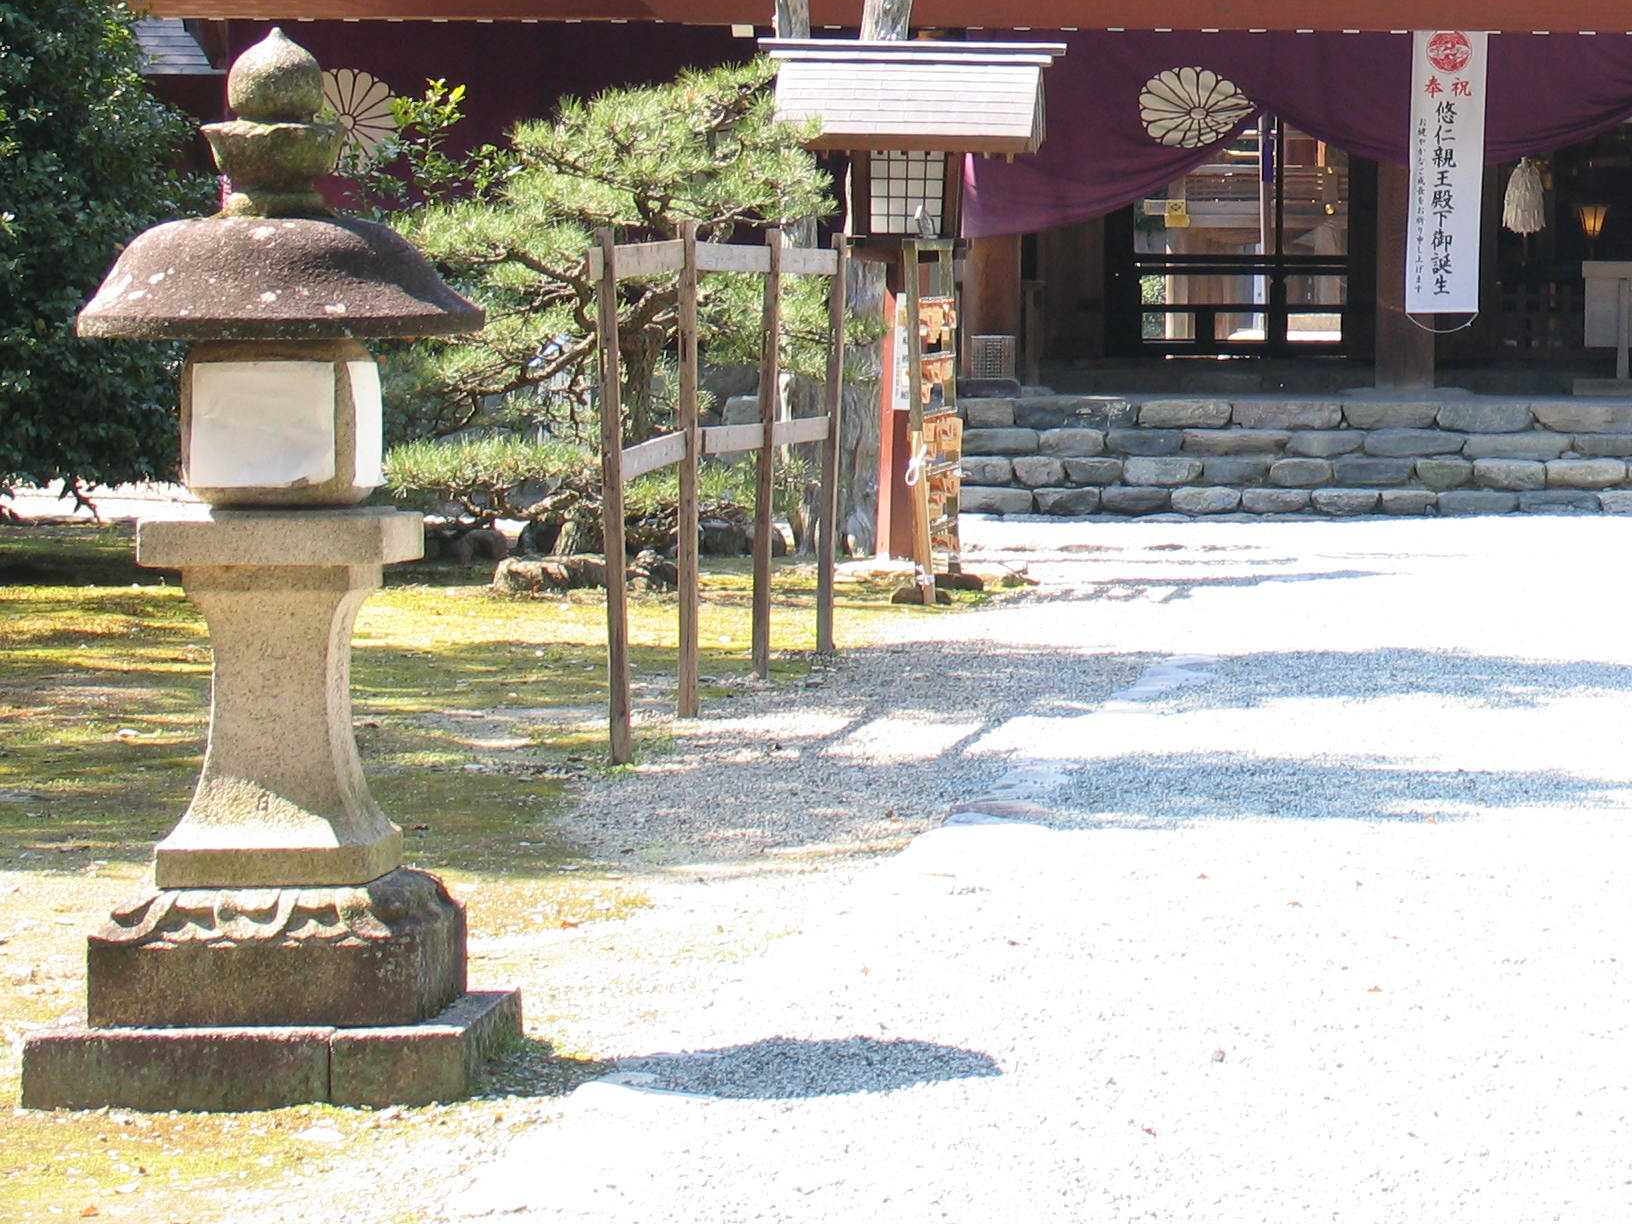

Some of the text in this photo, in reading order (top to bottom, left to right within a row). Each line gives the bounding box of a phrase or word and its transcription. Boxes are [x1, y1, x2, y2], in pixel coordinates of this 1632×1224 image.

[1424, 76, 1472, 98] 奉祝
[1431, 101, 1457, 295] 悠仁親王殿下御誕生
